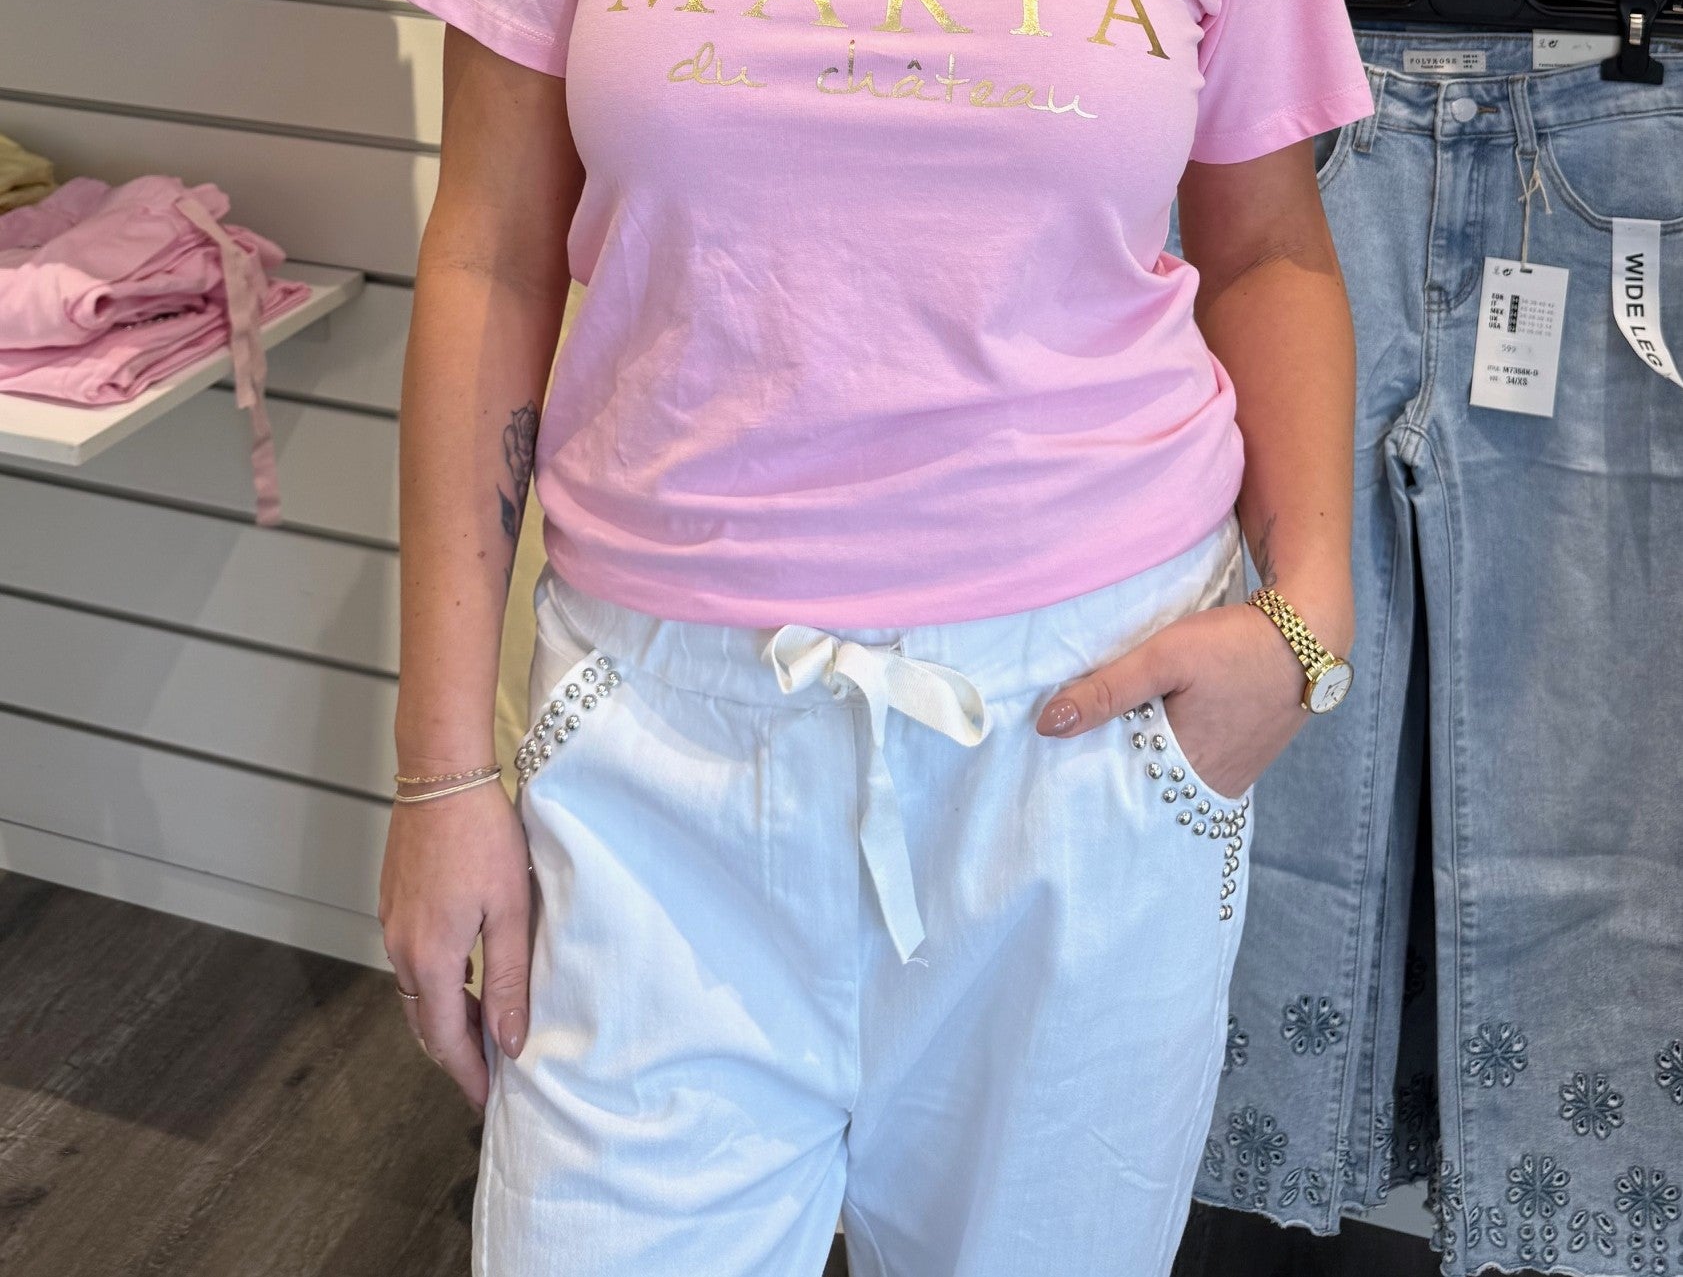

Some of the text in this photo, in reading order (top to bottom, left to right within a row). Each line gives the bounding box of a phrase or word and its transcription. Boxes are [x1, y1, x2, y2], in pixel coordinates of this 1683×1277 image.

[667, 39, 1098, 119] du château
[1625, 253, 1663, 367] WIDE LEG
[1506, 375, 1528, 386] 34/XS
